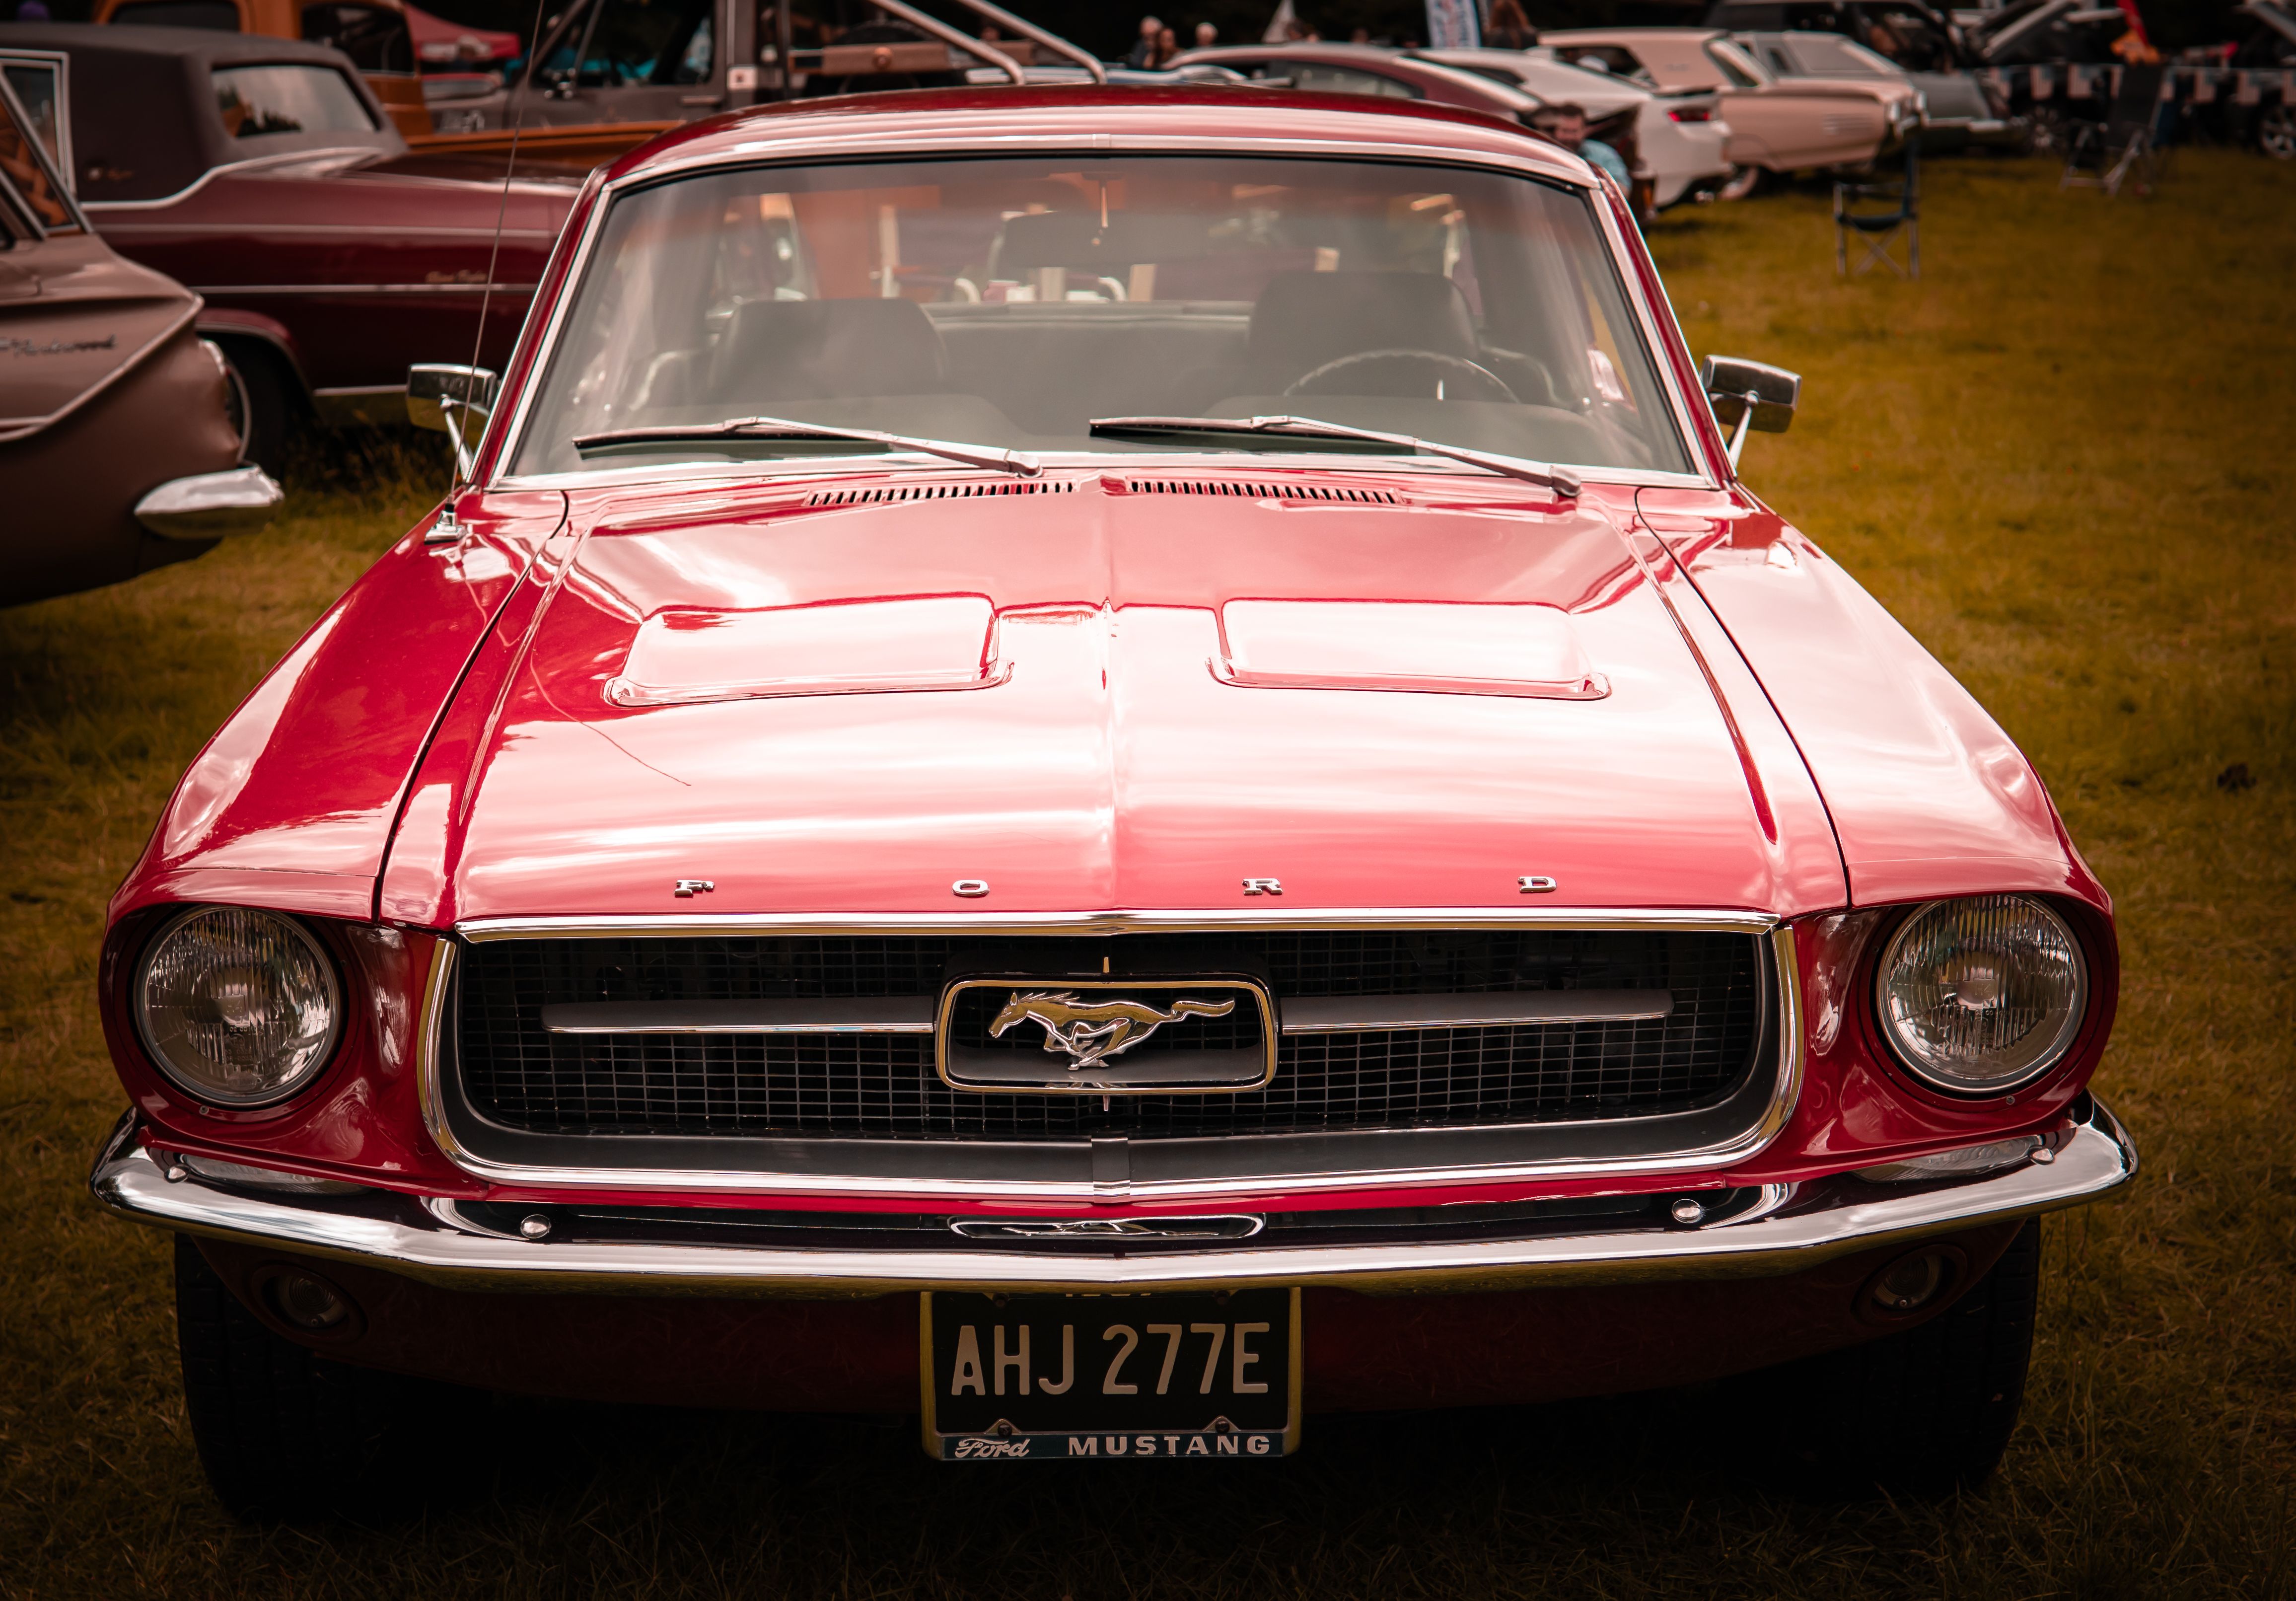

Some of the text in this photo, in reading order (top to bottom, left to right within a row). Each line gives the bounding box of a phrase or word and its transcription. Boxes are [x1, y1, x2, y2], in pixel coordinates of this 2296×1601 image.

[674, 876, 1557, 898] FORD
[951, 1322, 1270, 1395] AHJ 277E
[954, 1435, 1270, 1458] Ford MUSTANG
